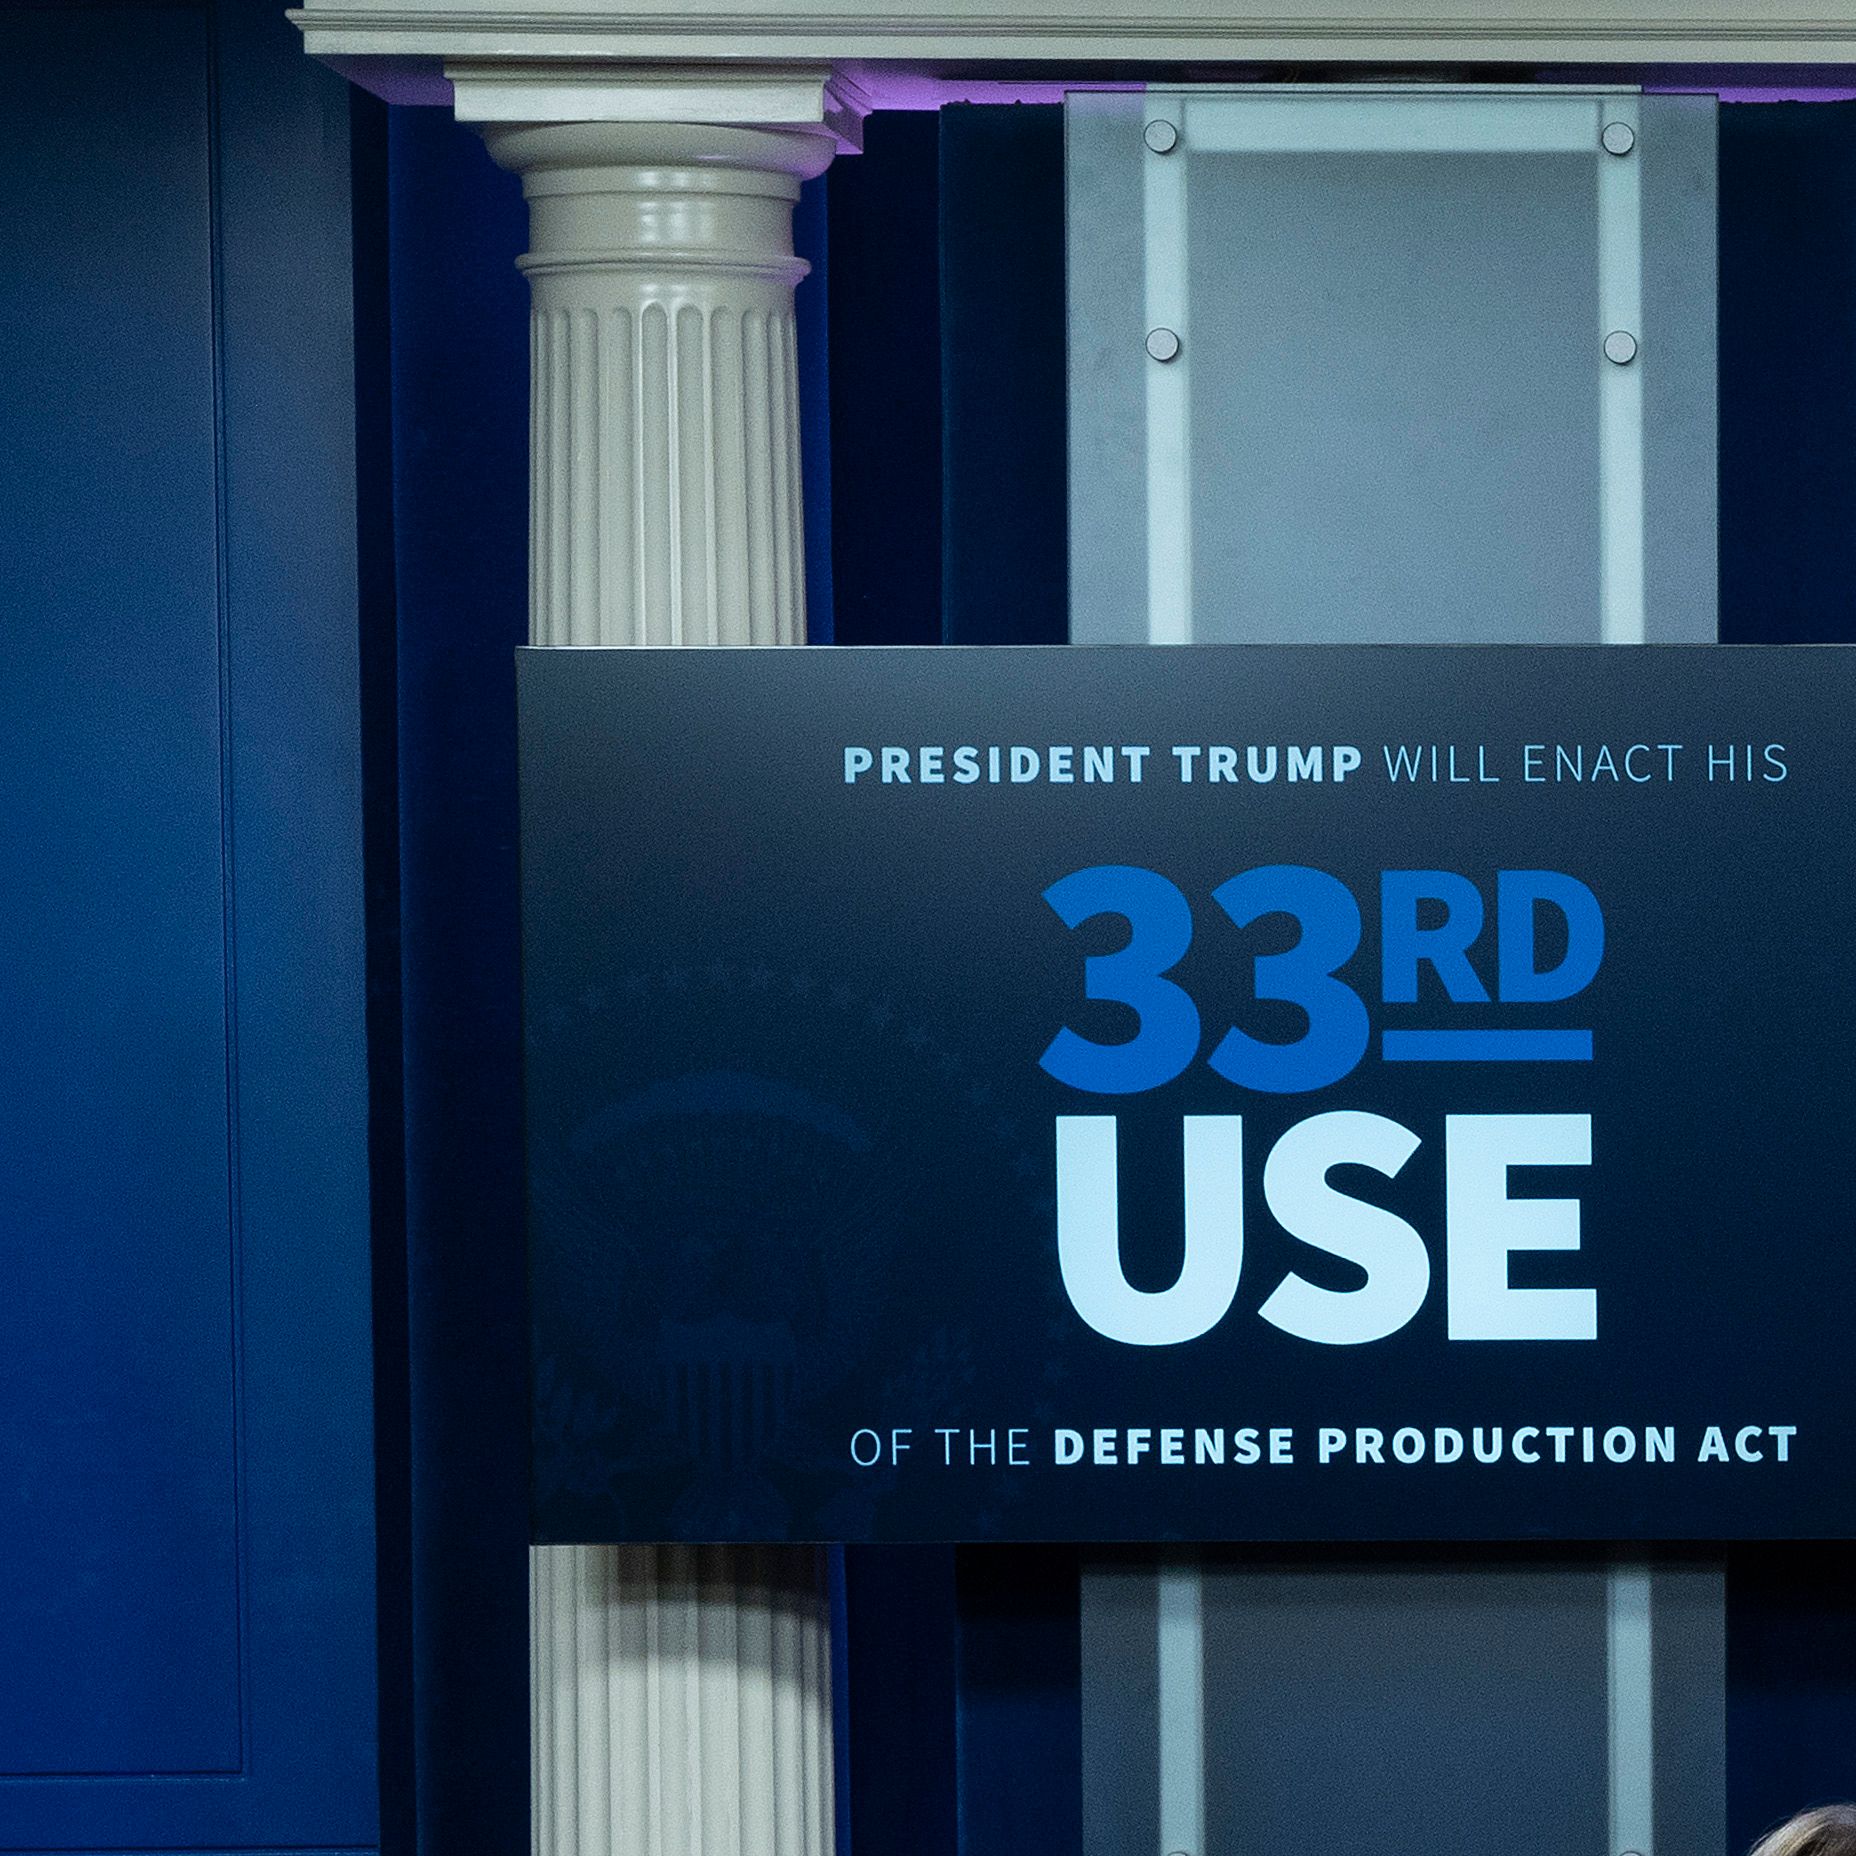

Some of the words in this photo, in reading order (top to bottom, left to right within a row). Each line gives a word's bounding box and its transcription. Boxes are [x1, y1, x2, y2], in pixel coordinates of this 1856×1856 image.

[845, 746, 1152, 785] PRESIDENT
[1172, 746, 1363, 785] TRUMP
[1384, 746, 1501, 783] WILL
[1525, 745, 1684, 784] ENACT
[1709, 744, 1788, 783] HIS
[1037, 864, 1607, 1096] 33RD
[1056, 1110, 1599, 1347] USE
[851, 1429, 914, 1467] OF
[935, 1429, 1031, 1466] THE
[1055, 1428, 1295, 1466] DEFENSE
[1319, 1426, 1676, 1465] PRODUCTION
[1698, 1426, 1798, 1464] ACT
